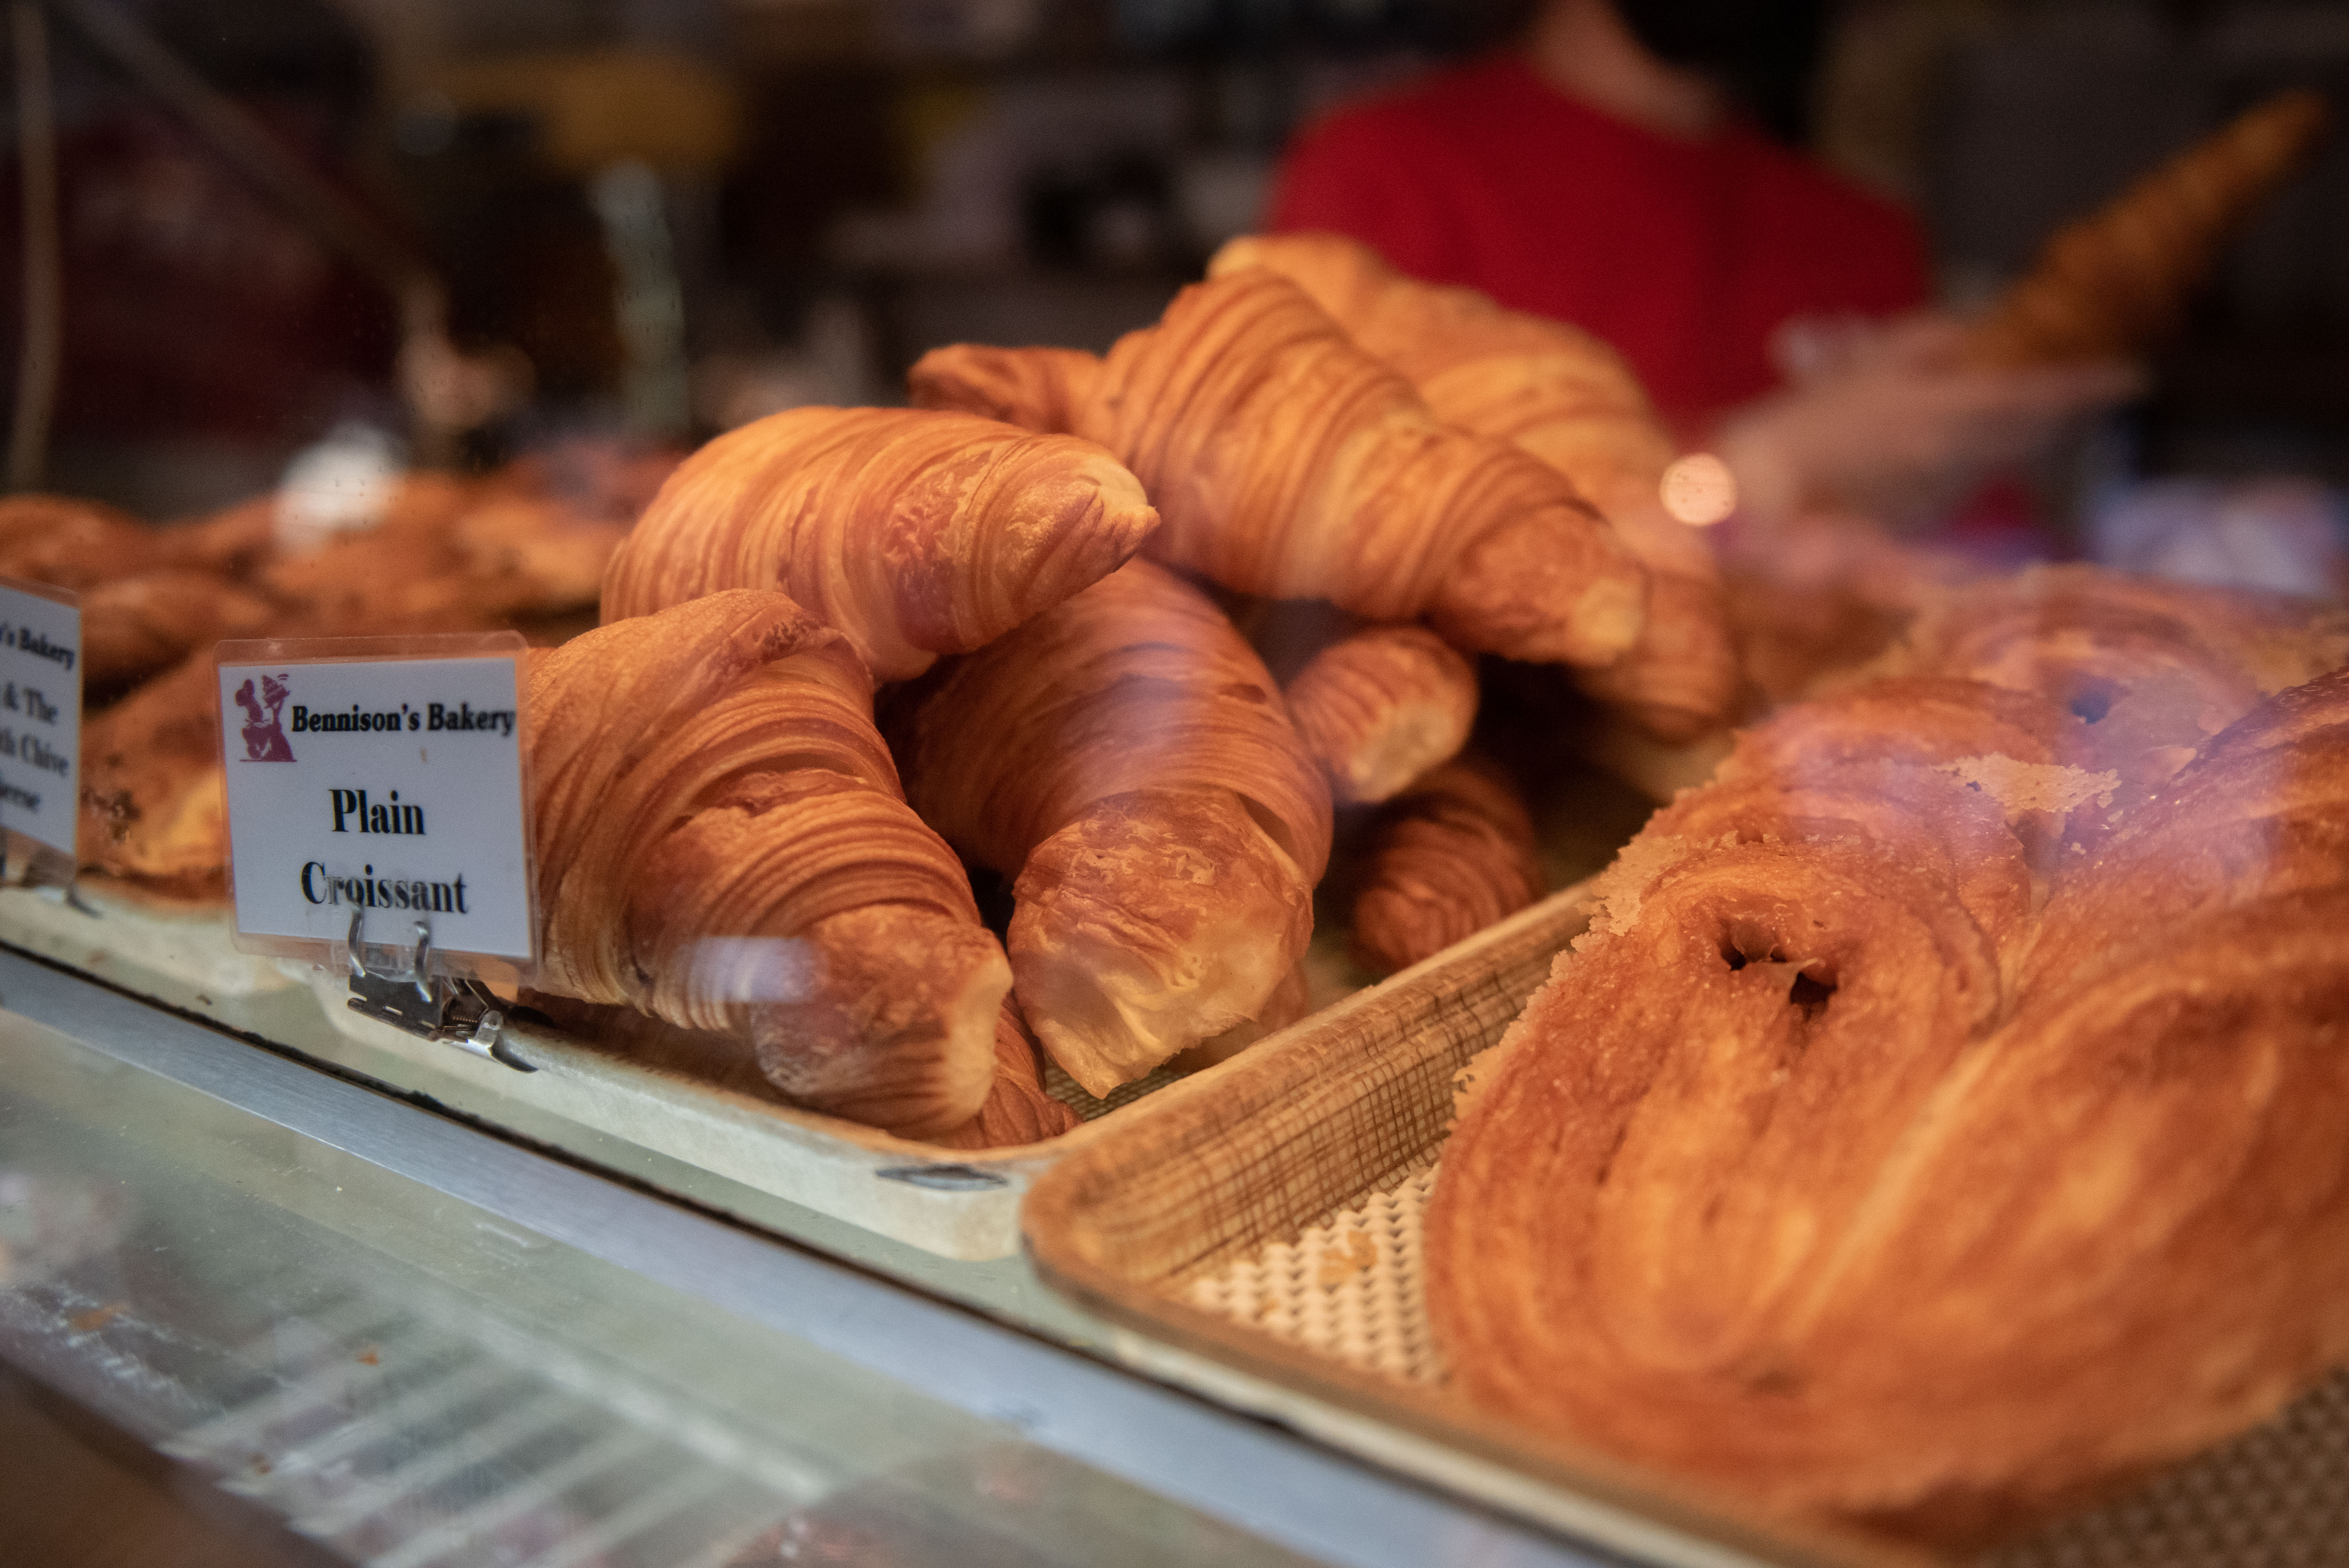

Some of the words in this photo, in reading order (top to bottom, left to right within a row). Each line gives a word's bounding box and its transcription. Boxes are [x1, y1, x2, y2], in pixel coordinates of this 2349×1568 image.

[19, 626, 75, 671] Bakery
[291, 704, 421, 732] Bennison's
[427, 702, 516, 738] Bakery
[328, 788, 426, 836] Plain
[300, 861, 469, 914] Croissant
